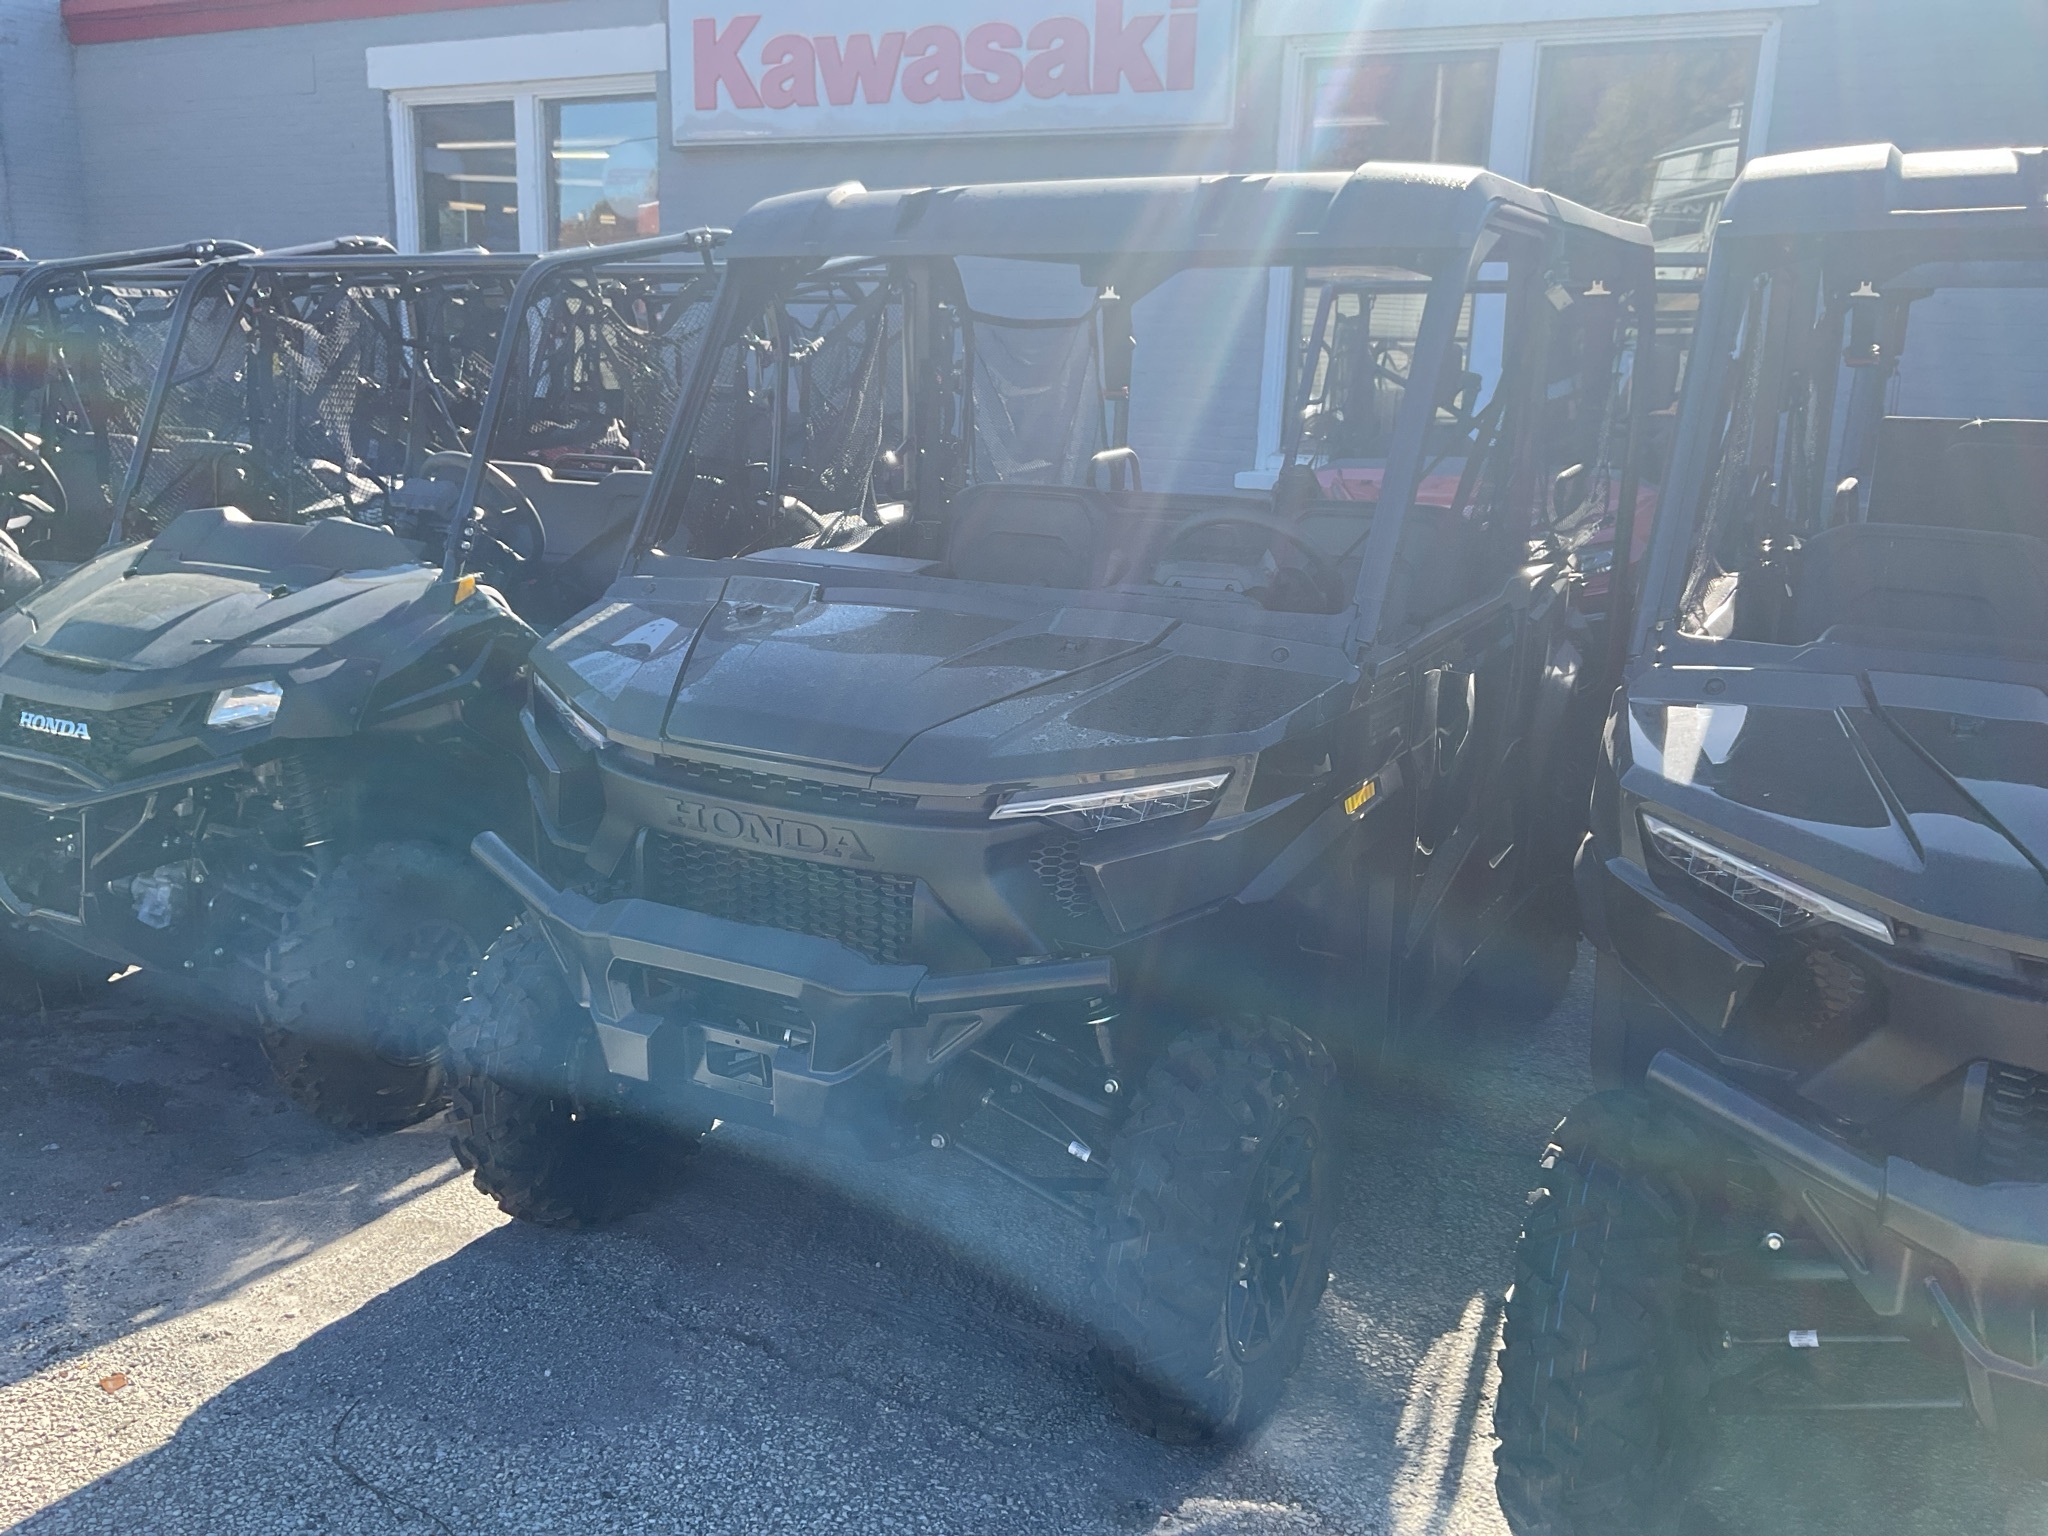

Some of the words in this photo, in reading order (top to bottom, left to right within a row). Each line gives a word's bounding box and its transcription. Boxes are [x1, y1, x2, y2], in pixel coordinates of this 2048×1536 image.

[692, 0, 1198, 111] Kawasaki
[19, 711, 91, 740] HONDA
[664, 797, 875, 862] HONDA
